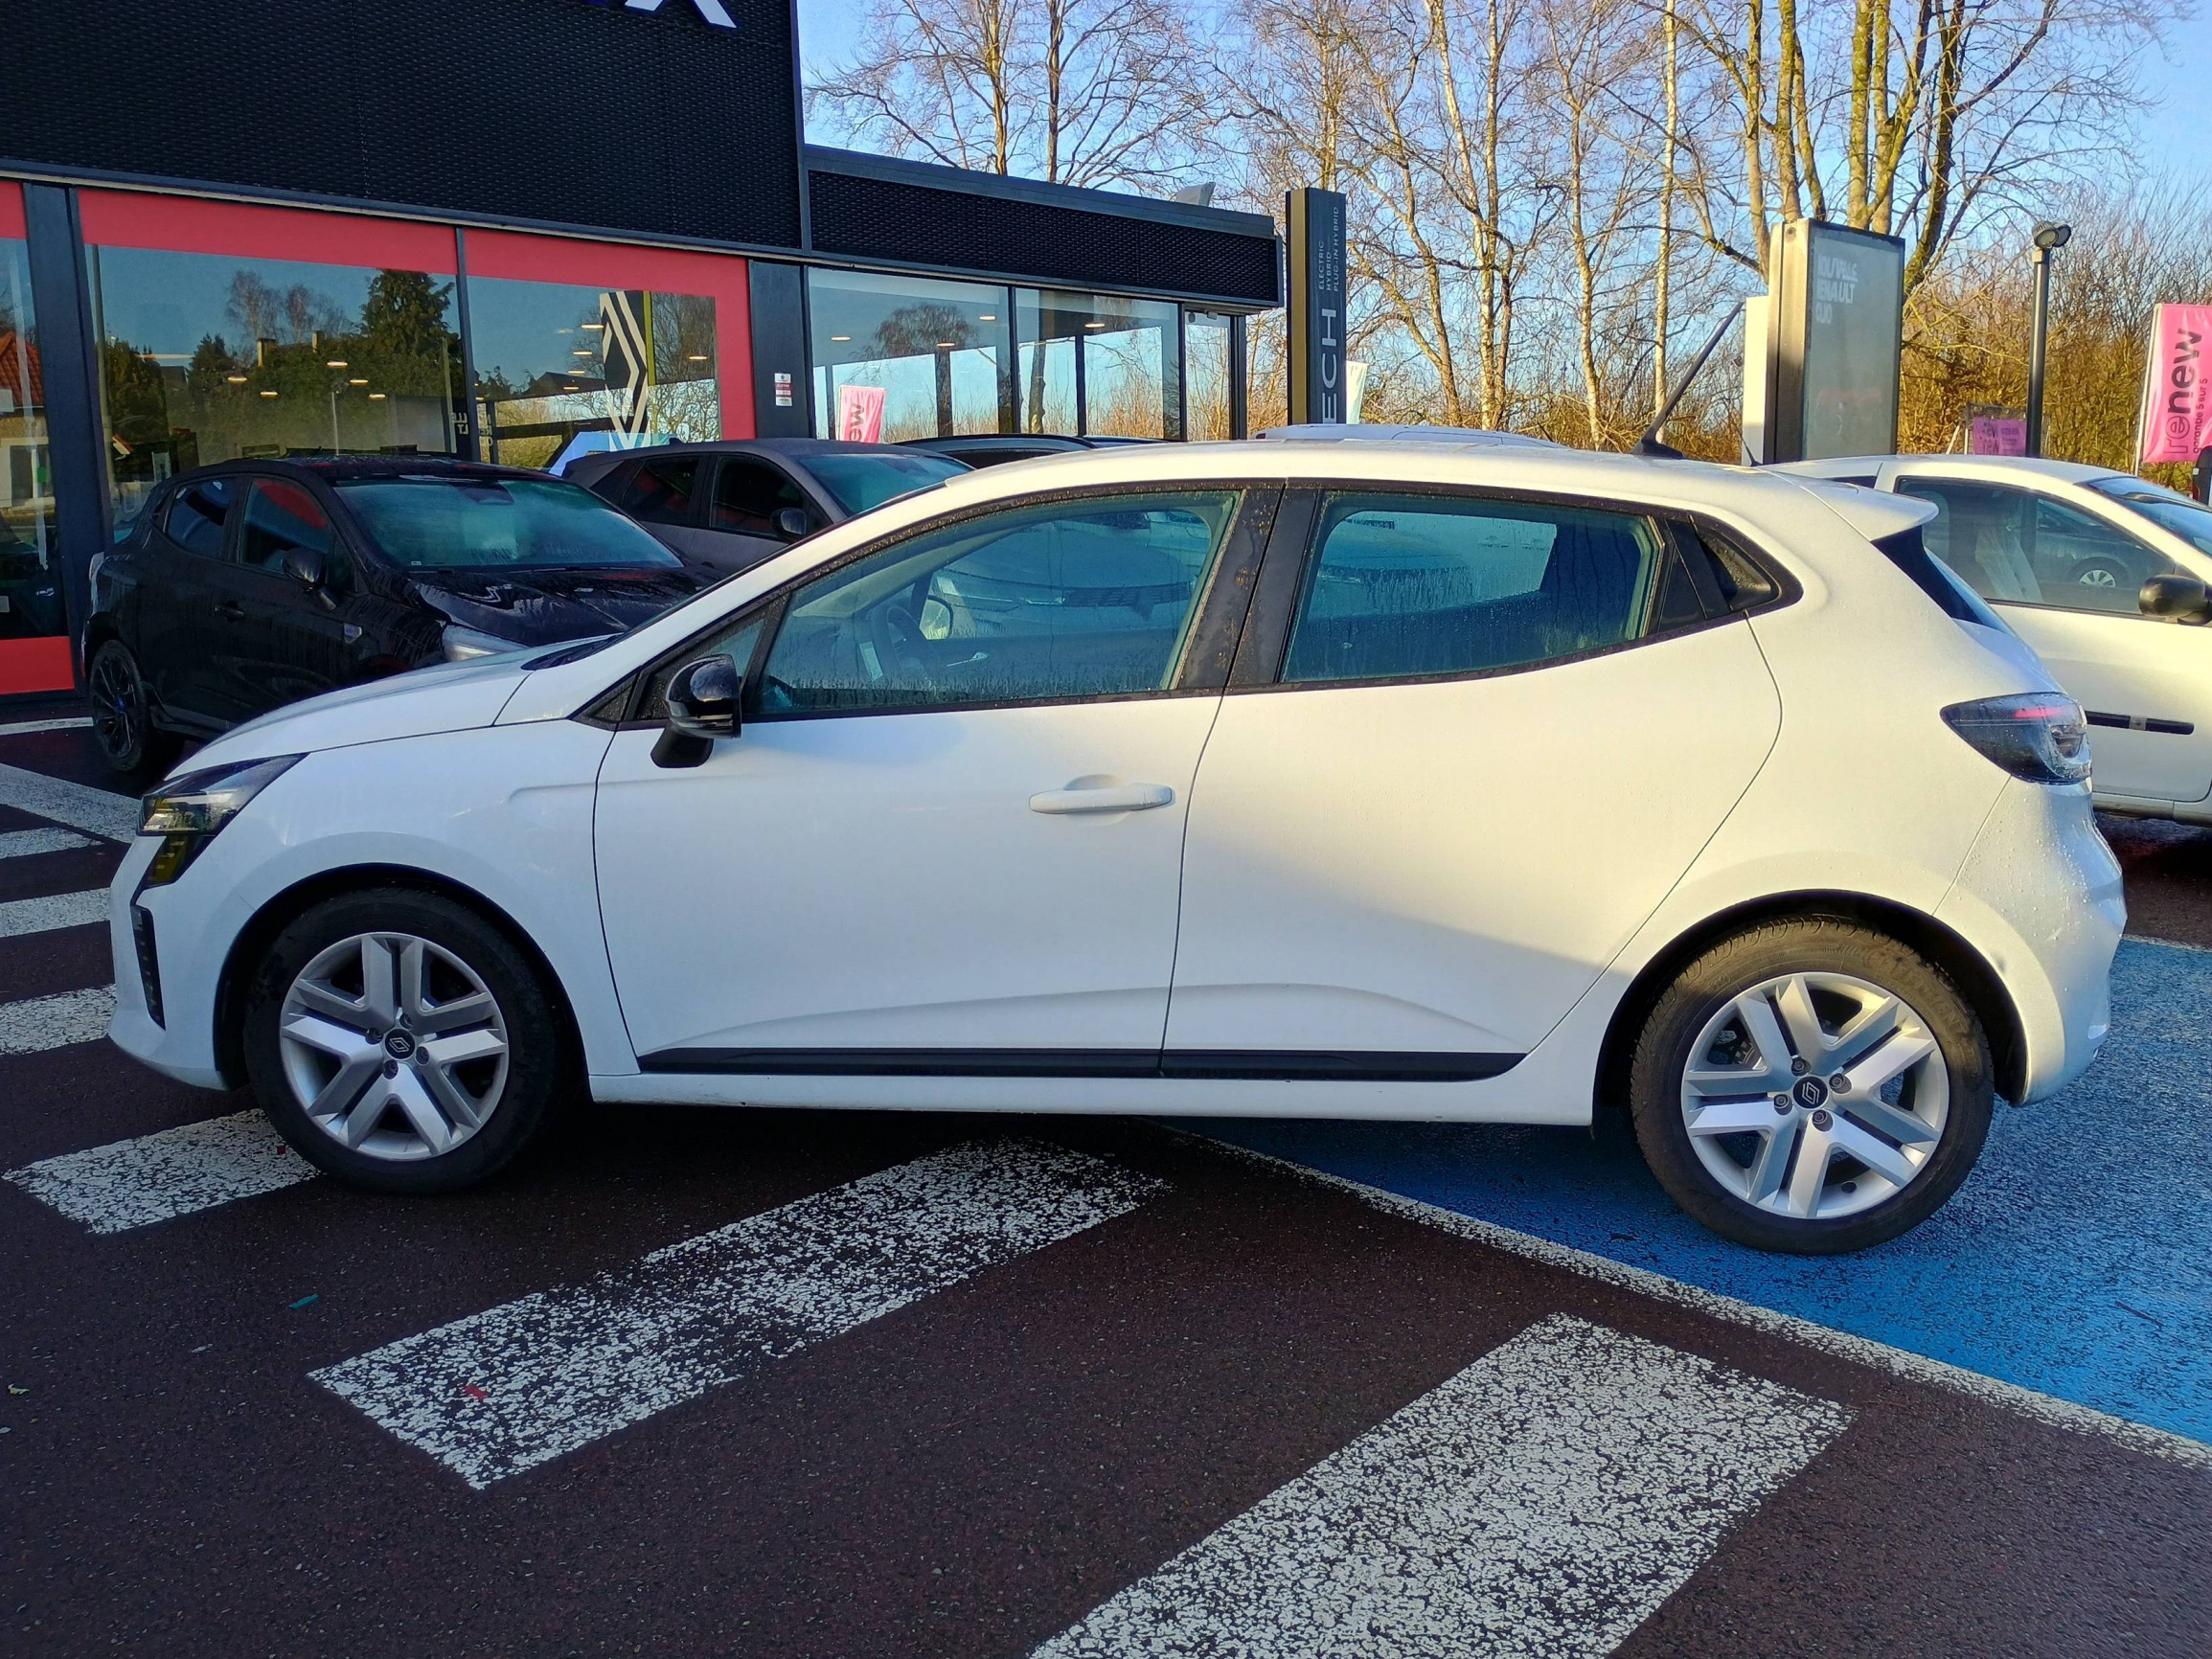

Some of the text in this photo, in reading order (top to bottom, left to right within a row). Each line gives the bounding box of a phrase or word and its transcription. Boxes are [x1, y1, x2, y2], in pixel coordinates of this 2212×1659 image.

[2162, 328, 2202, 455] renew
[2192, 411, 2204, 455] garantie
[2198, 386, 2207, 402] sur
